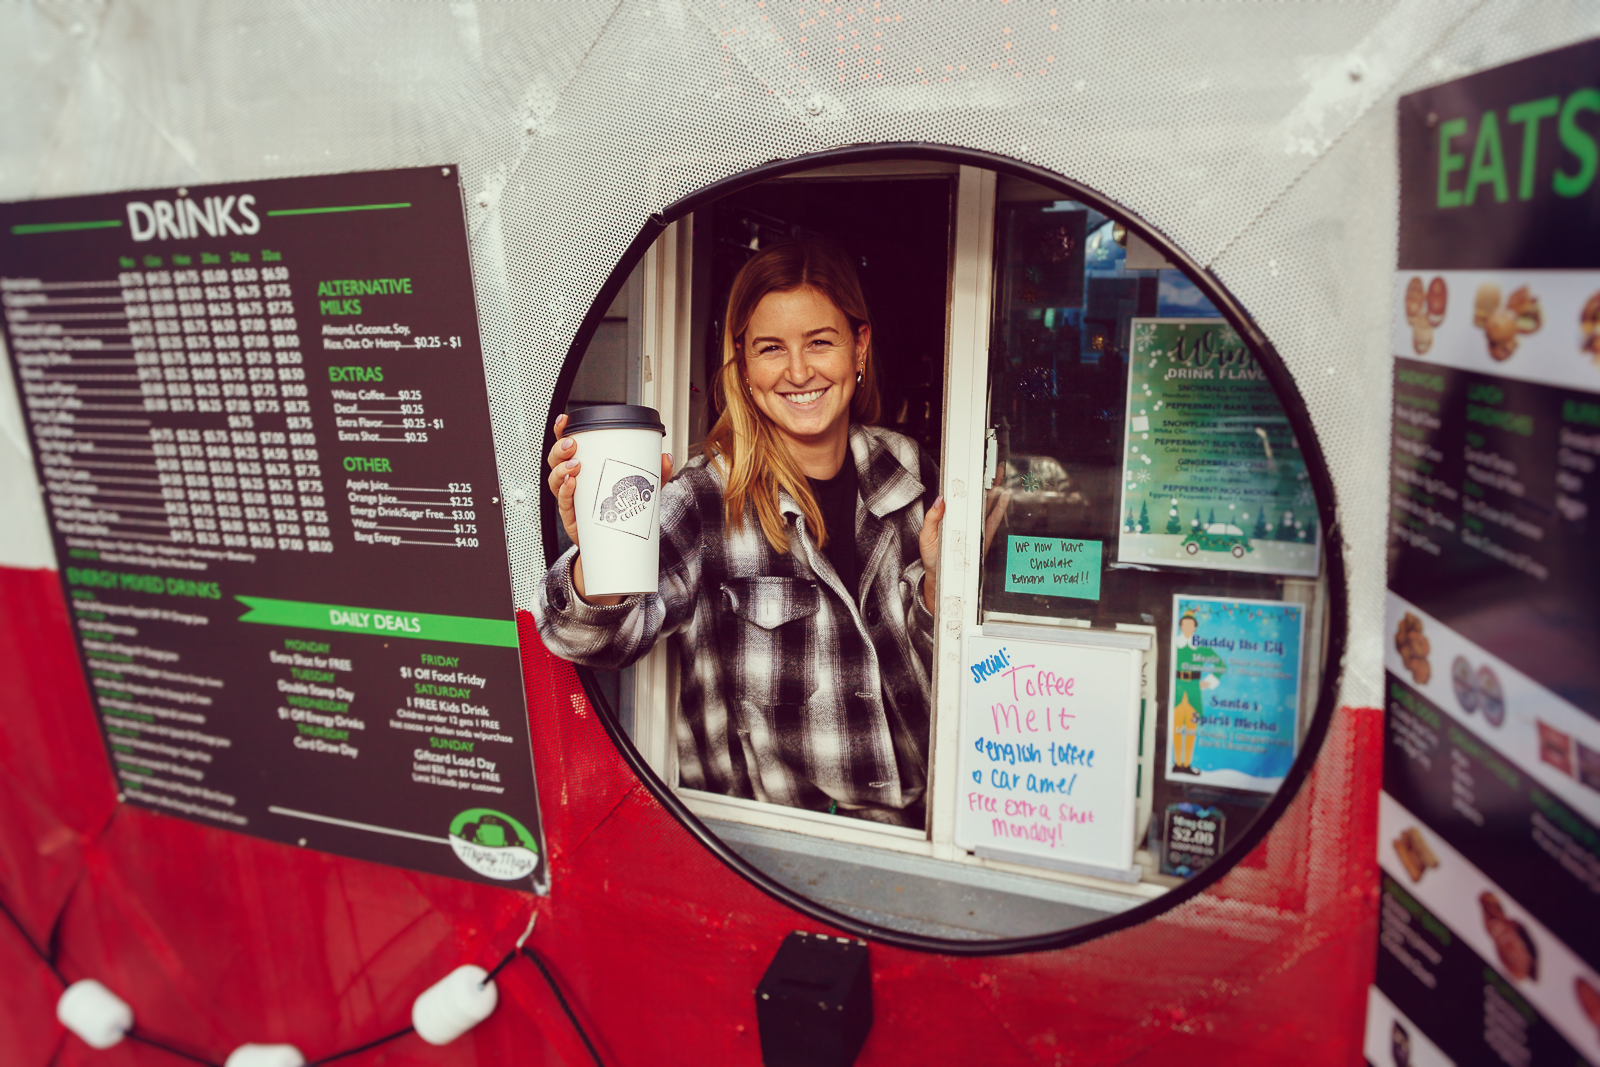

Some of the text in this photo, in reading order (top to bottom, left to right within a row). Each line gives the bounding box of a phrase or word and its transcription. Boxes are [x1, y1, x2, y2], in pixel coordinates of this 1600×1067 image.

[1437, 87, 1600, 209] EATS
[126, 194, 260, 242] DRINKS
[317, 278, 413, 296] ALTERNATIVE
[320, 299, 362, 315] MILKS
[414, 336, 441, 349] $0.25
[450, 336, 461, 349] $1
[1172, 330, 1256, 369] Win
[328, 366, 384, 382] EXTRAS
[1167, 367, 1267, 381] DRINK FLAVO
[358, 390, 385, 400] Coffee
[398, 390, 422, 401] $0.25
[400, 404, 424, 415] $0.25
[358, 417, 383, 427] Flavor
[402, 418, 426, 429] $0.25
[433, 418, 444, 430] $1
[404, 432, 428, 443] $0.25
[343, 457, 392, 473] OTHER
[346, 479, 472, 493] Apple Juice $2.25
[348, 492, 473, 507] Orange Juice $2.25
[350, 505, 376, 518] Energy
[425, 509, 444, 519] Free
[452, 510, 476, 521] $3.00
[620, 502, 647, 522] COFFEE
[453, 524, 477, 534] $1.75
[374, 532, 401, 546] Energy
[455, 537, 479, 548] $4.00
[1015, 540, 1084, 553] We now have
[1011, 573, 1045, 584] Banana
[166, 577, 222, 600] DRINKS
[329, 609, 421, 633] DAILY DEALS
[284, 638, 330, 654] MONDAY
[1191, 635, 1286, 657] Buddy the Elf
[421, 653, 459, 668] FRIDAY
[290, 667, 335, 683] TUESDAY
[400, 666, 486, 689] $1 Off Food Friday
[1001, 664, 1075, 701] Toffee
[414, 683, 472, 700] SATURDAY
[286, 695, 349, 713] WEDNESDAY
[413, 697, 438, 711] FREE
[438, 700, 461, 714] Kids
[461, 703, 490, 717] Drink
[481, 719, 500, 731] FREE
[991, 702, 1076, 735] Melt
[296, 722, 349, 741] THURSDAY
[429, 736, 475, 753] SUNDAY
[1048, 742, 1095, 768] toffee
[452, 754, 476, 768] Load
[476, 757, 497, 773] Day
[481, 771, 501, 783] FREE
[968, 792, 998, 814] Free
[1058, 803, 1095, 824] Shot
[991, 818, 1066, 848] Monday!
